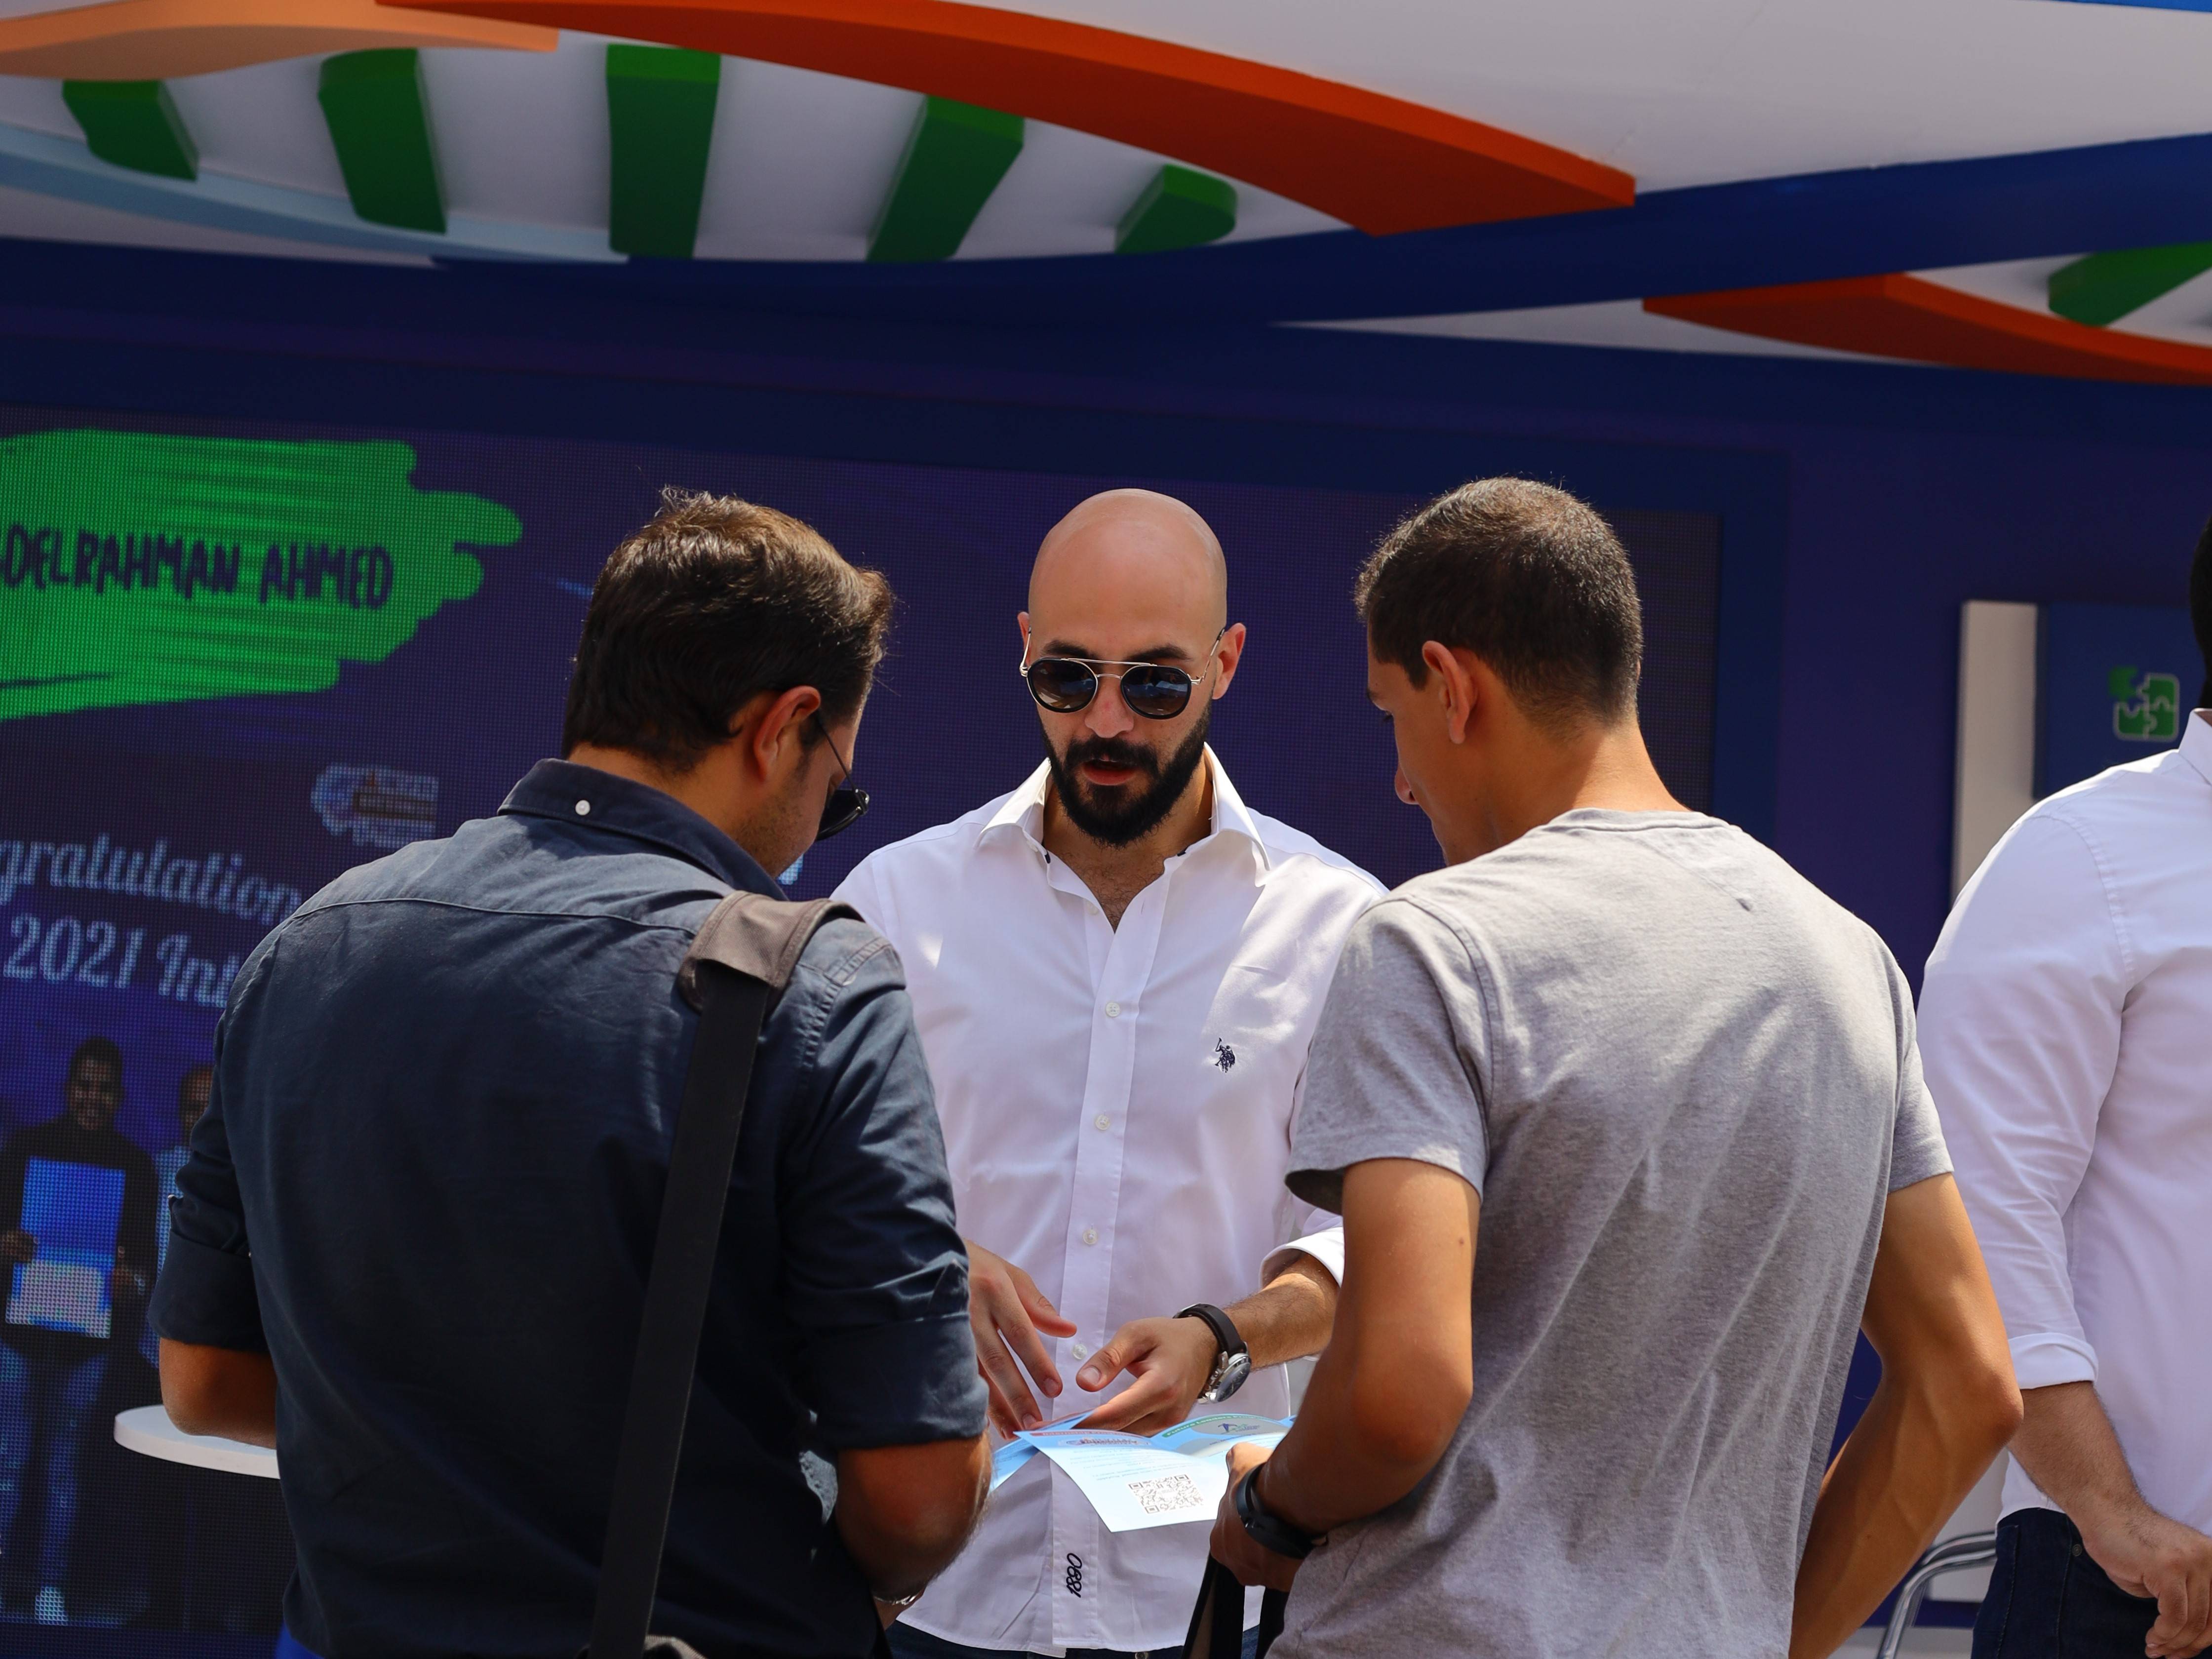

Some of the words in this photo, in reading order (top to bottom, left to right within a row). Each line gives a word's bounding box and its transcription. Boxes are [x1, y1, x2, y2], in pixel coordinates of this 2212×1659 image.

[0, 523, 240, 599] DELRAHMAN
[259, 542, 394, 610] AHMED
[2, 913, 146, 989] 2021
[1065, 1552, 1083, 1598] 1890
